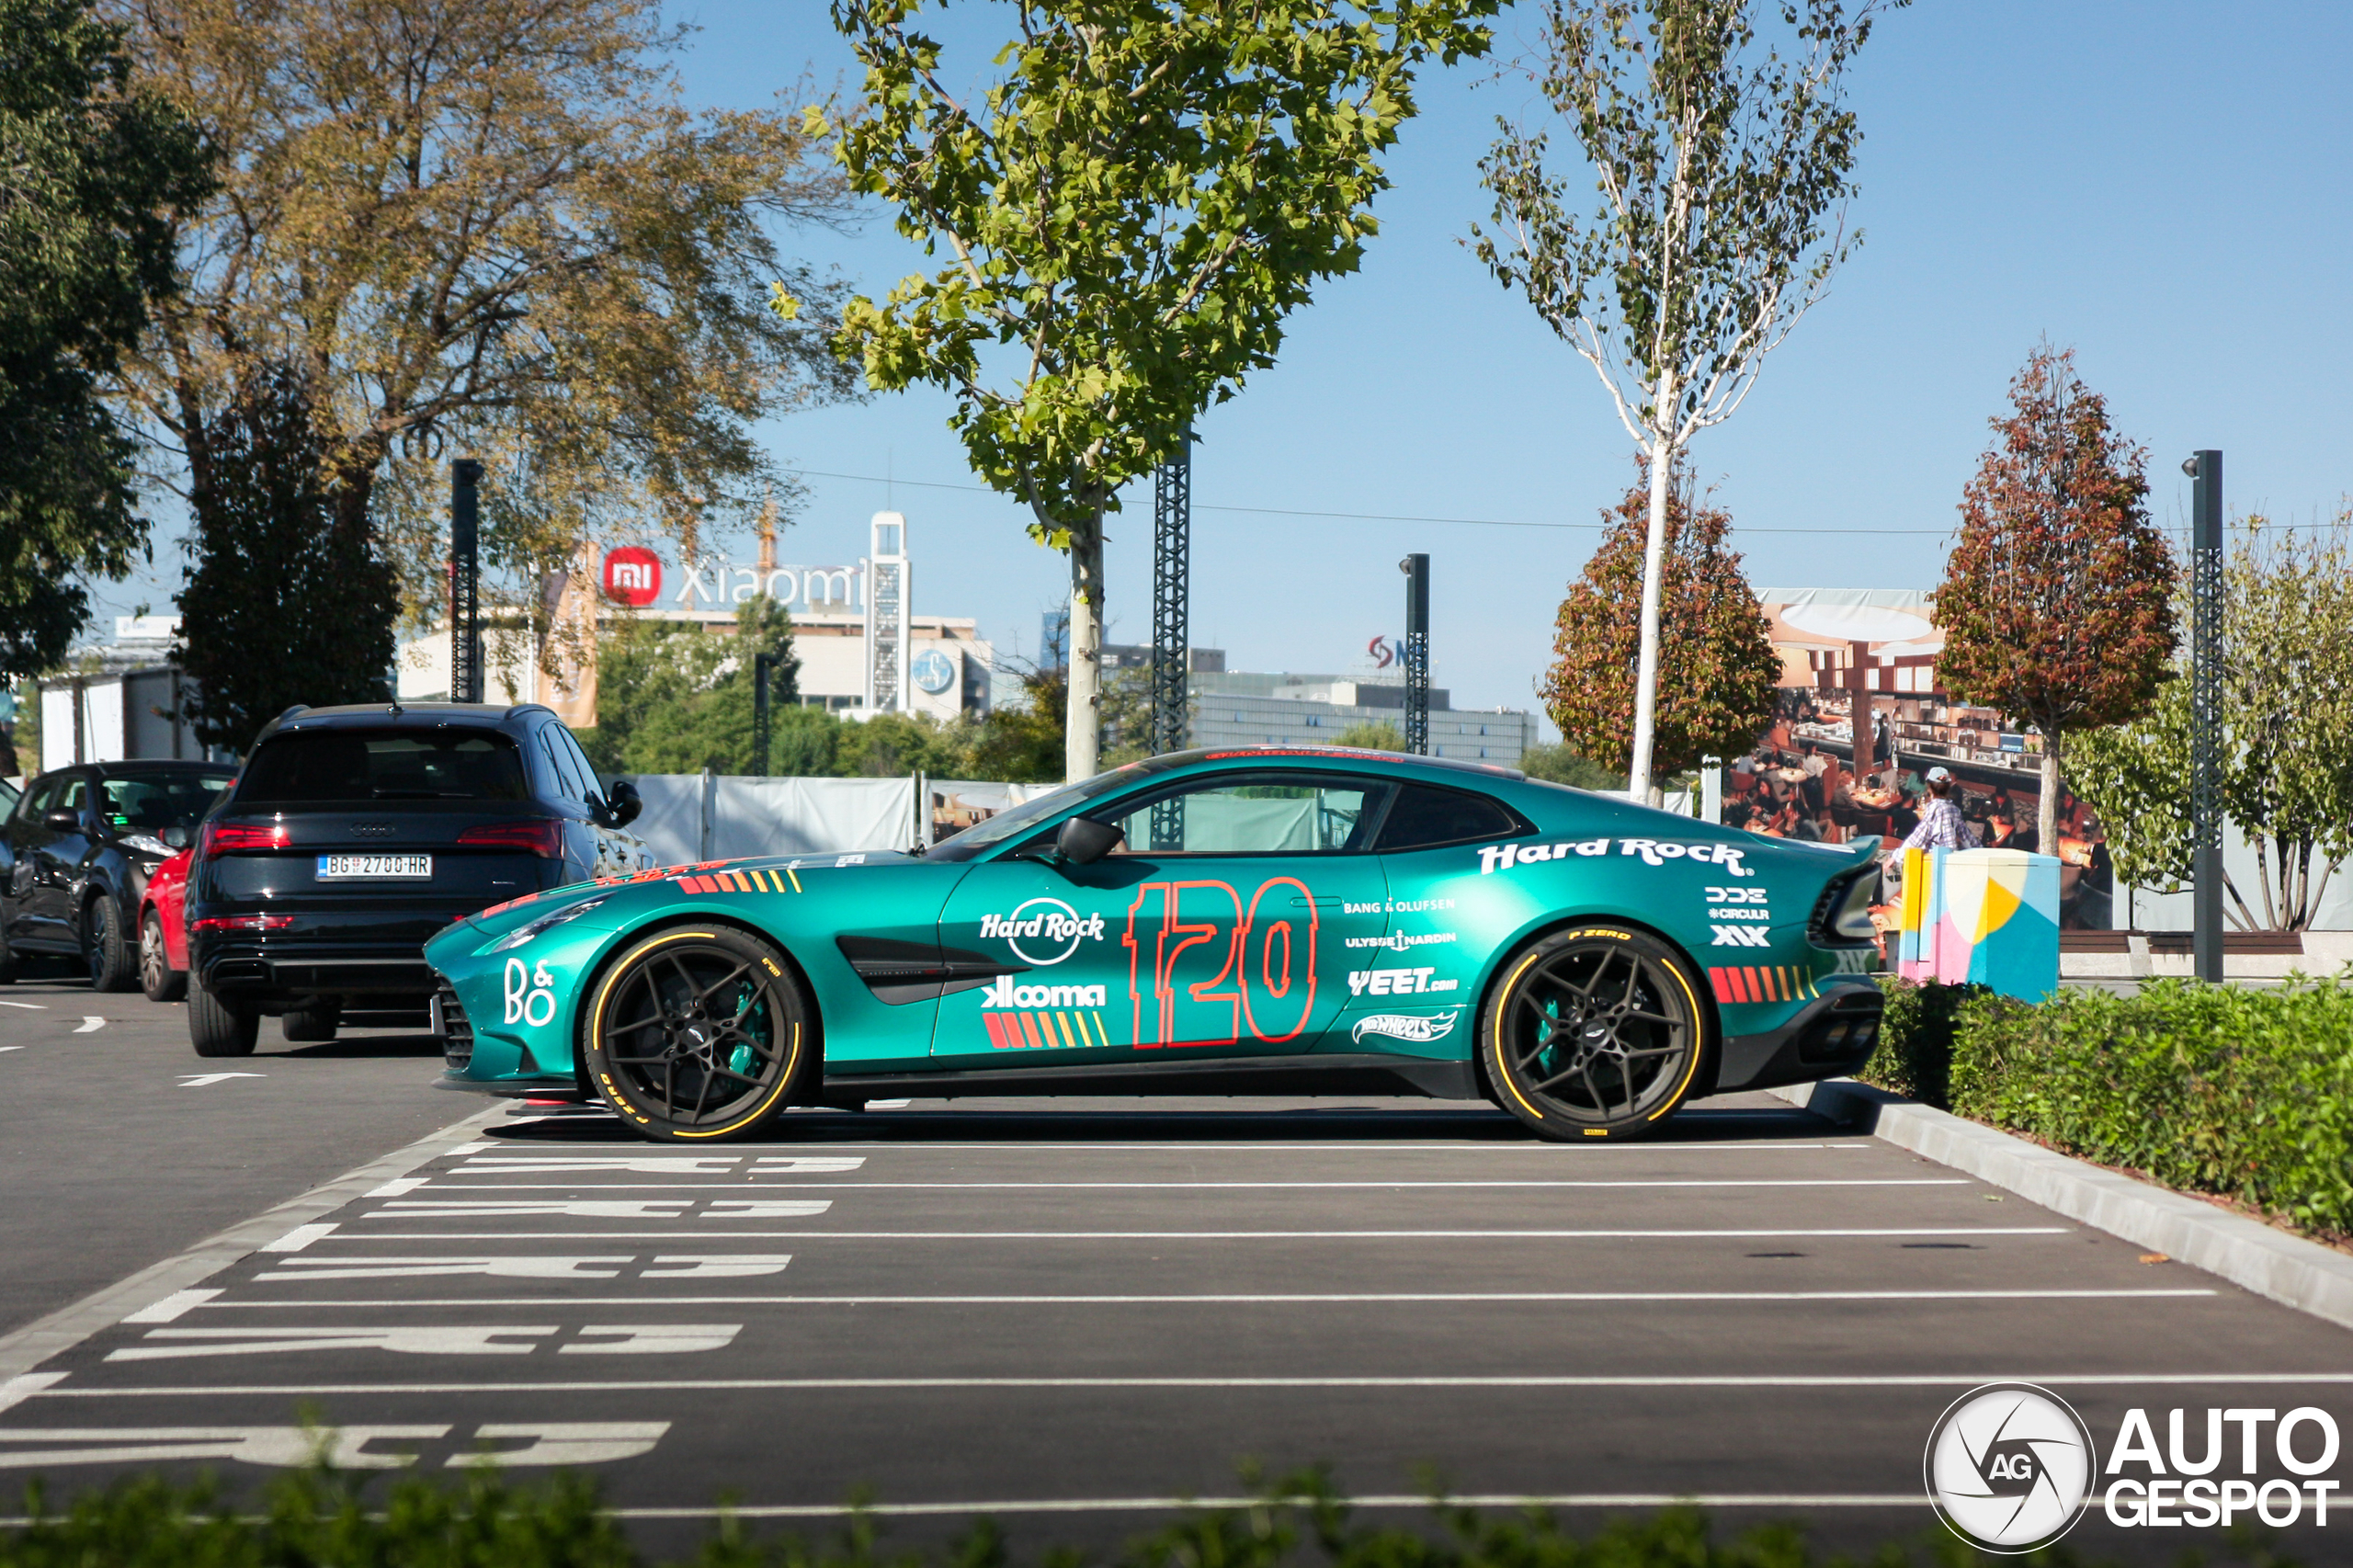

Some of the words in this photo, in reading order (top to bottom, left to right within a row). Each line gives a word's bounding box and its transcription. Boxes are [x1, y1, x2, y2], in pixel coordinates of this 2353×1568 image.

[330, 857, 349, 873] BG
[1477, 838, 1610, 875] Hard
[1704, 887, 1768, 904] DDE
[1344, 902, 1381, 914] BANG
[1396, 898, 1456, 913] OLUFSEN
[1719, 908, 1770, 920] CIRCULR
[980, 913, 1045, 938] Hard
[1044, 912, 1106, 942] Rock
[1569, 931, 1581, 940] P
[1584, 928, 1631, 941] ZERO
[1345, 937, 1395, 949] ULYSSE
[1404, 932, 1457, 946] NARDIN
[1121, 876, 1319, 1050] 120
[600, 1074, 635, 1114] ZERO
